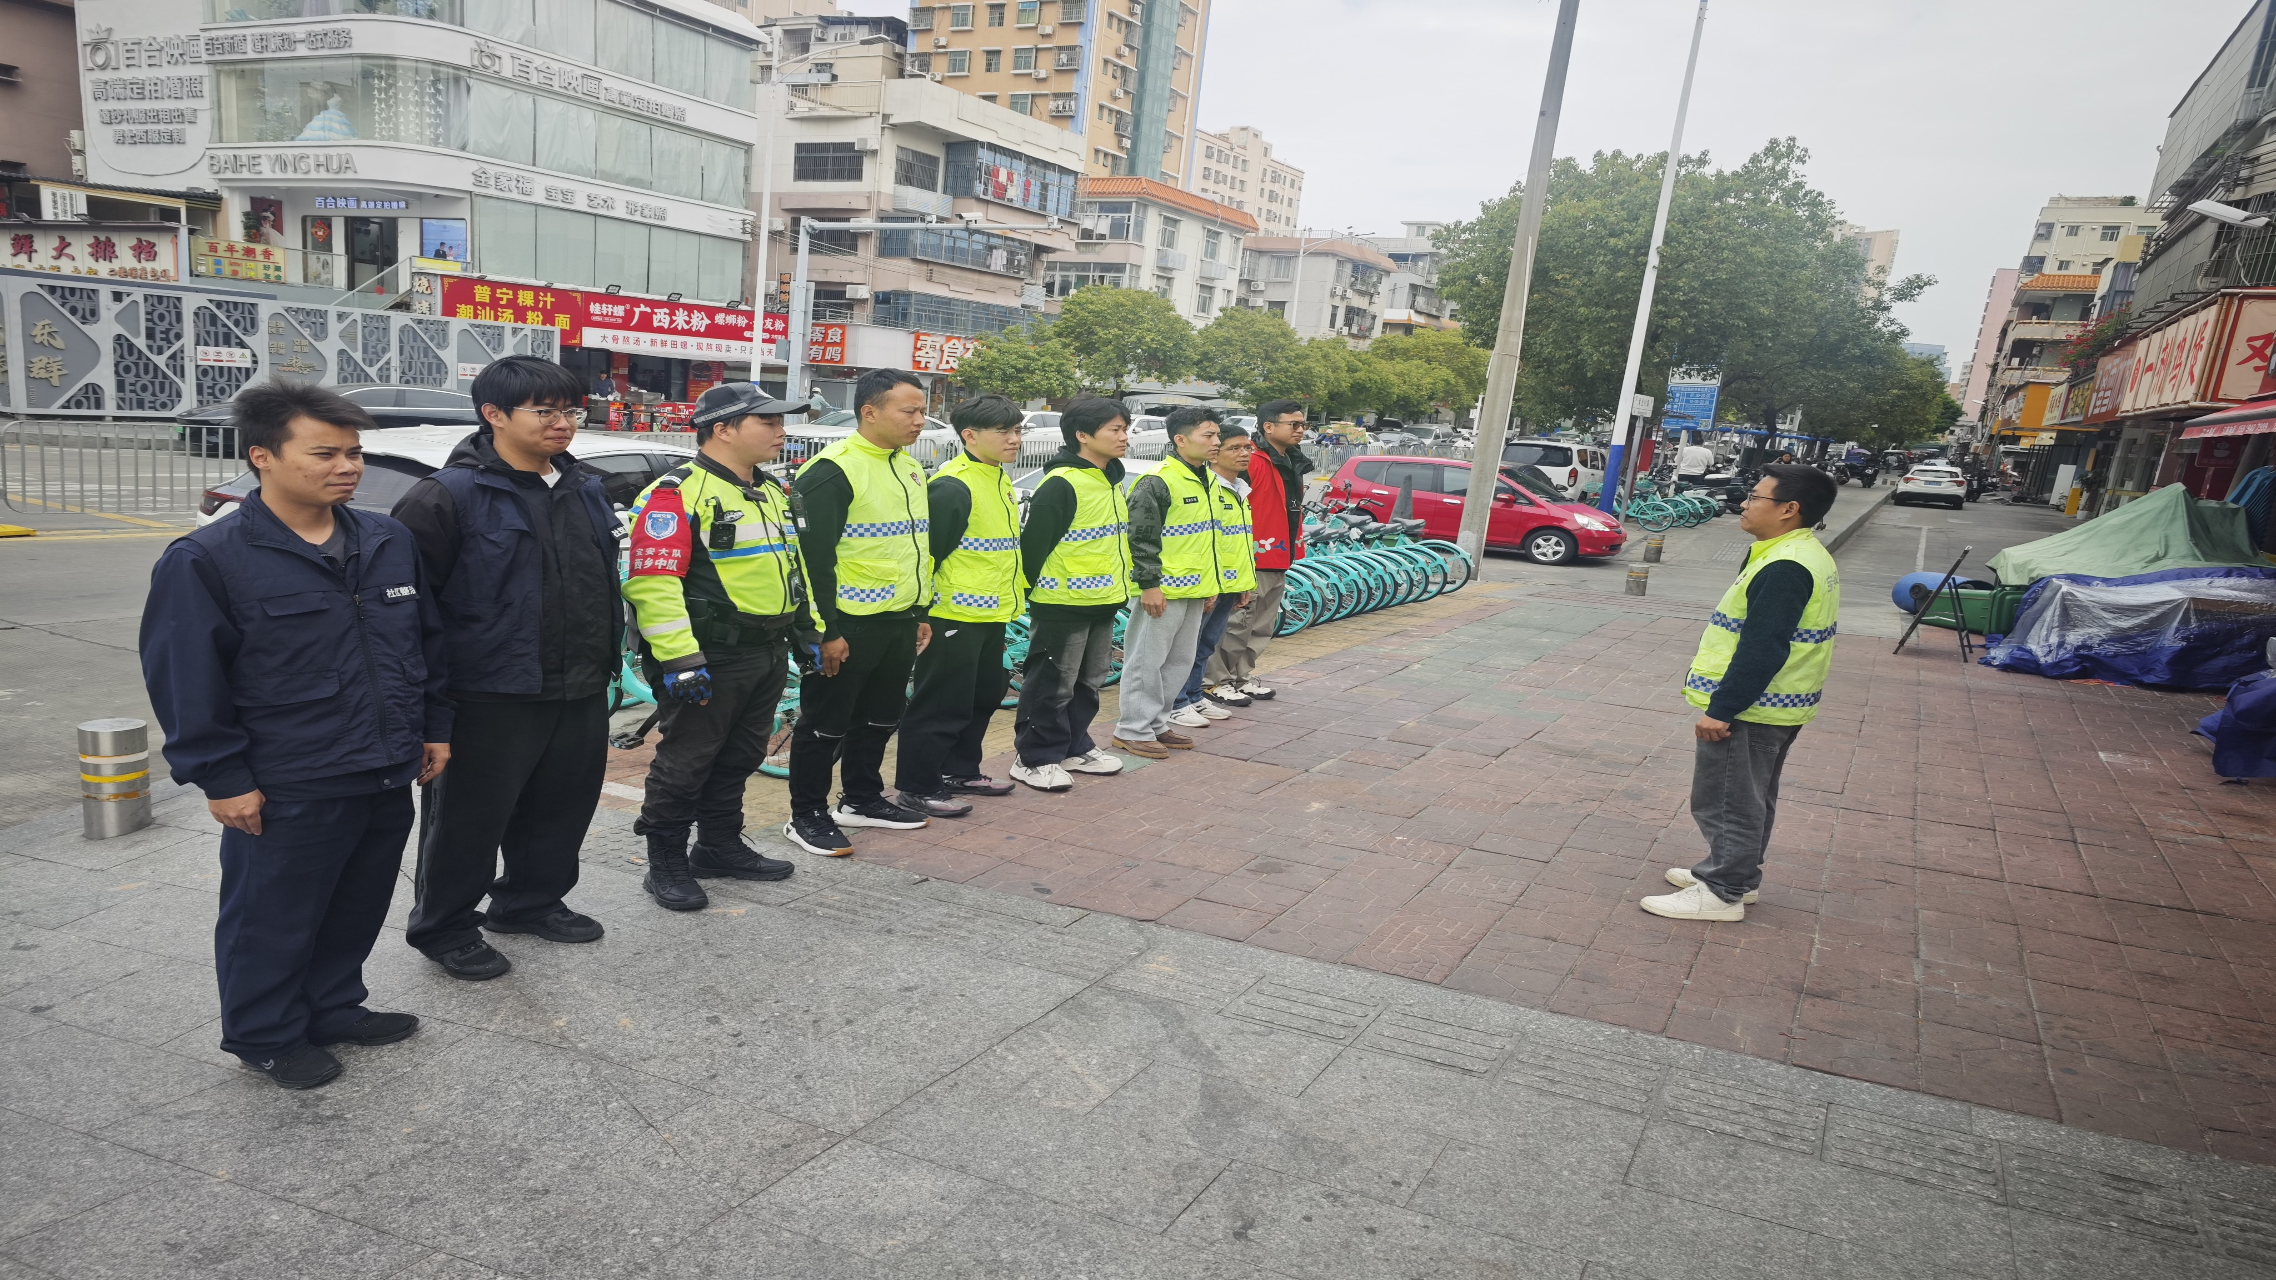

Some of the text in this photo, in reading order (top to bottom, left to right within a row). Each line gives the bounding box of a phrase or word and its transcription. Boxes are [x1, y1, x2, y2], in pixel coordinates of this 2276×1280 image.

[120, 34, 203, 68] 百合映画
[510, 52, 603, 99] 百合映画
[90, 76, 204, 101] 高端定拍婚照
[207, 152, 358, 174] BAIHE YING HUA
[315, 197, 358, 209] 百合映画
[472, 166, 667, 221] 全家福 宝宝 艺术 形象照
[10, 233, 158, 263] 鲜大排档
[205, 241, 275, 261] 百年潮香
[474, 285, 556, 310] 普宁粿汁
[629, 303, 712, 333] 广西米粉
[810, 326, 843, 343] 零食
[808, 345, 842, 361] 有鸣
[1135, 525, 1156, 536] EAT
[636, 547, 682, 558] 宝安大队
[634, 558, 679, 572] 西乡中队
